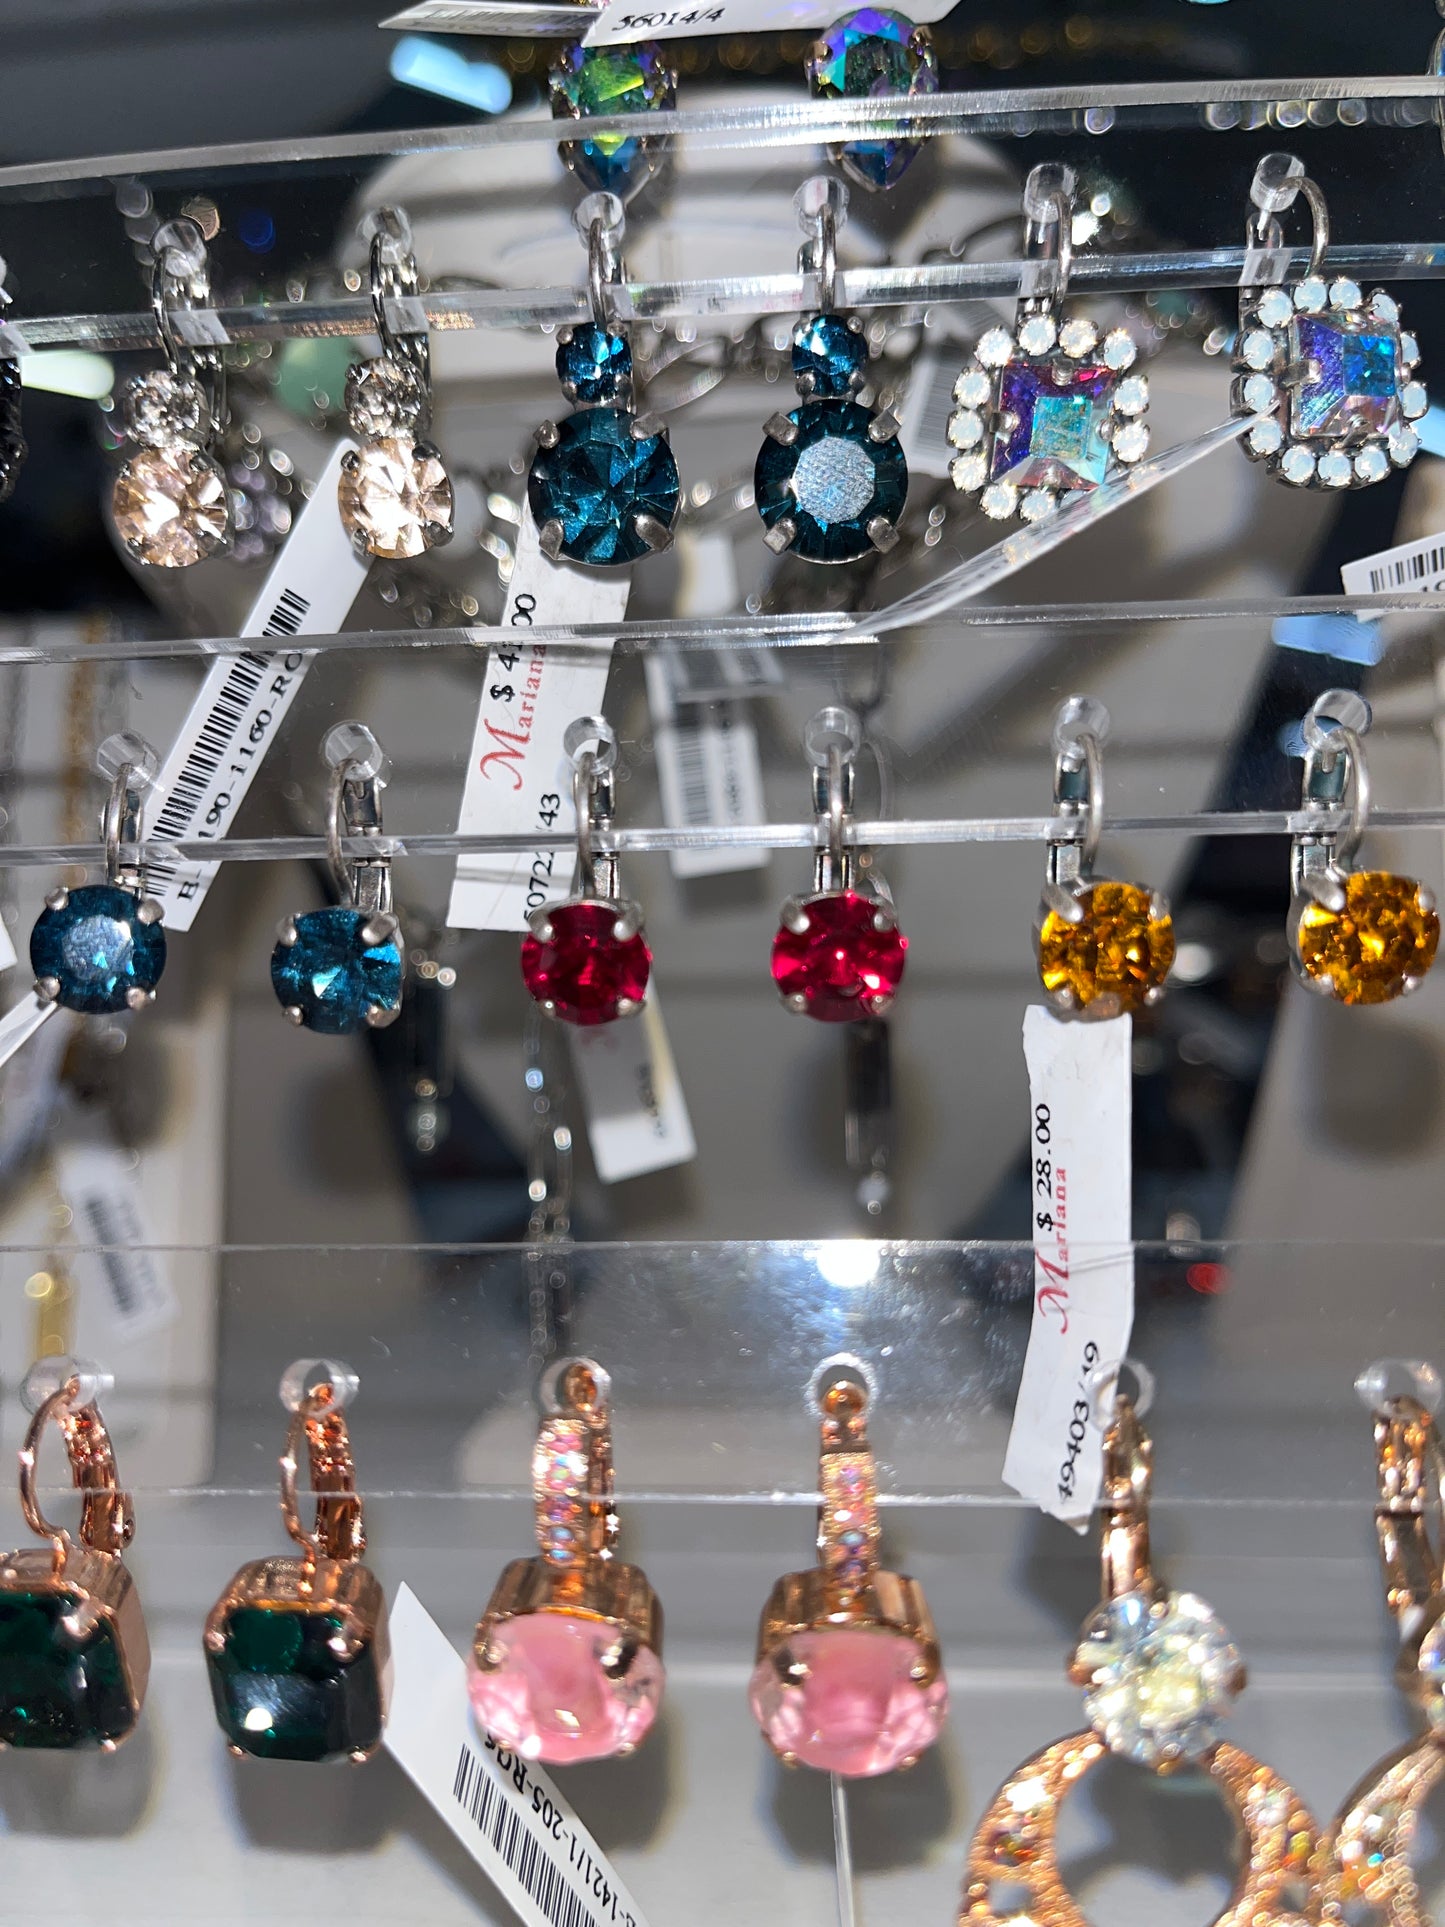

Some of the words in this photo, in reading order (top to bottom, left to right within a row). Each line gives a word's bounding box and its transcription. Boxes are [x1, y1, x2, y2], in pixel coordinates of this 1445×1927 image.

[612, 8, 725, 30] 56014/4
[479, 644, 547, 791] Mariana
[489, 683, 516, 702] $
[1034, 1103, 1053, 1199] 28.00
[1034, 1167, 1069, 1335] Mariana
[1036, 1213, 1054, 1231] $
